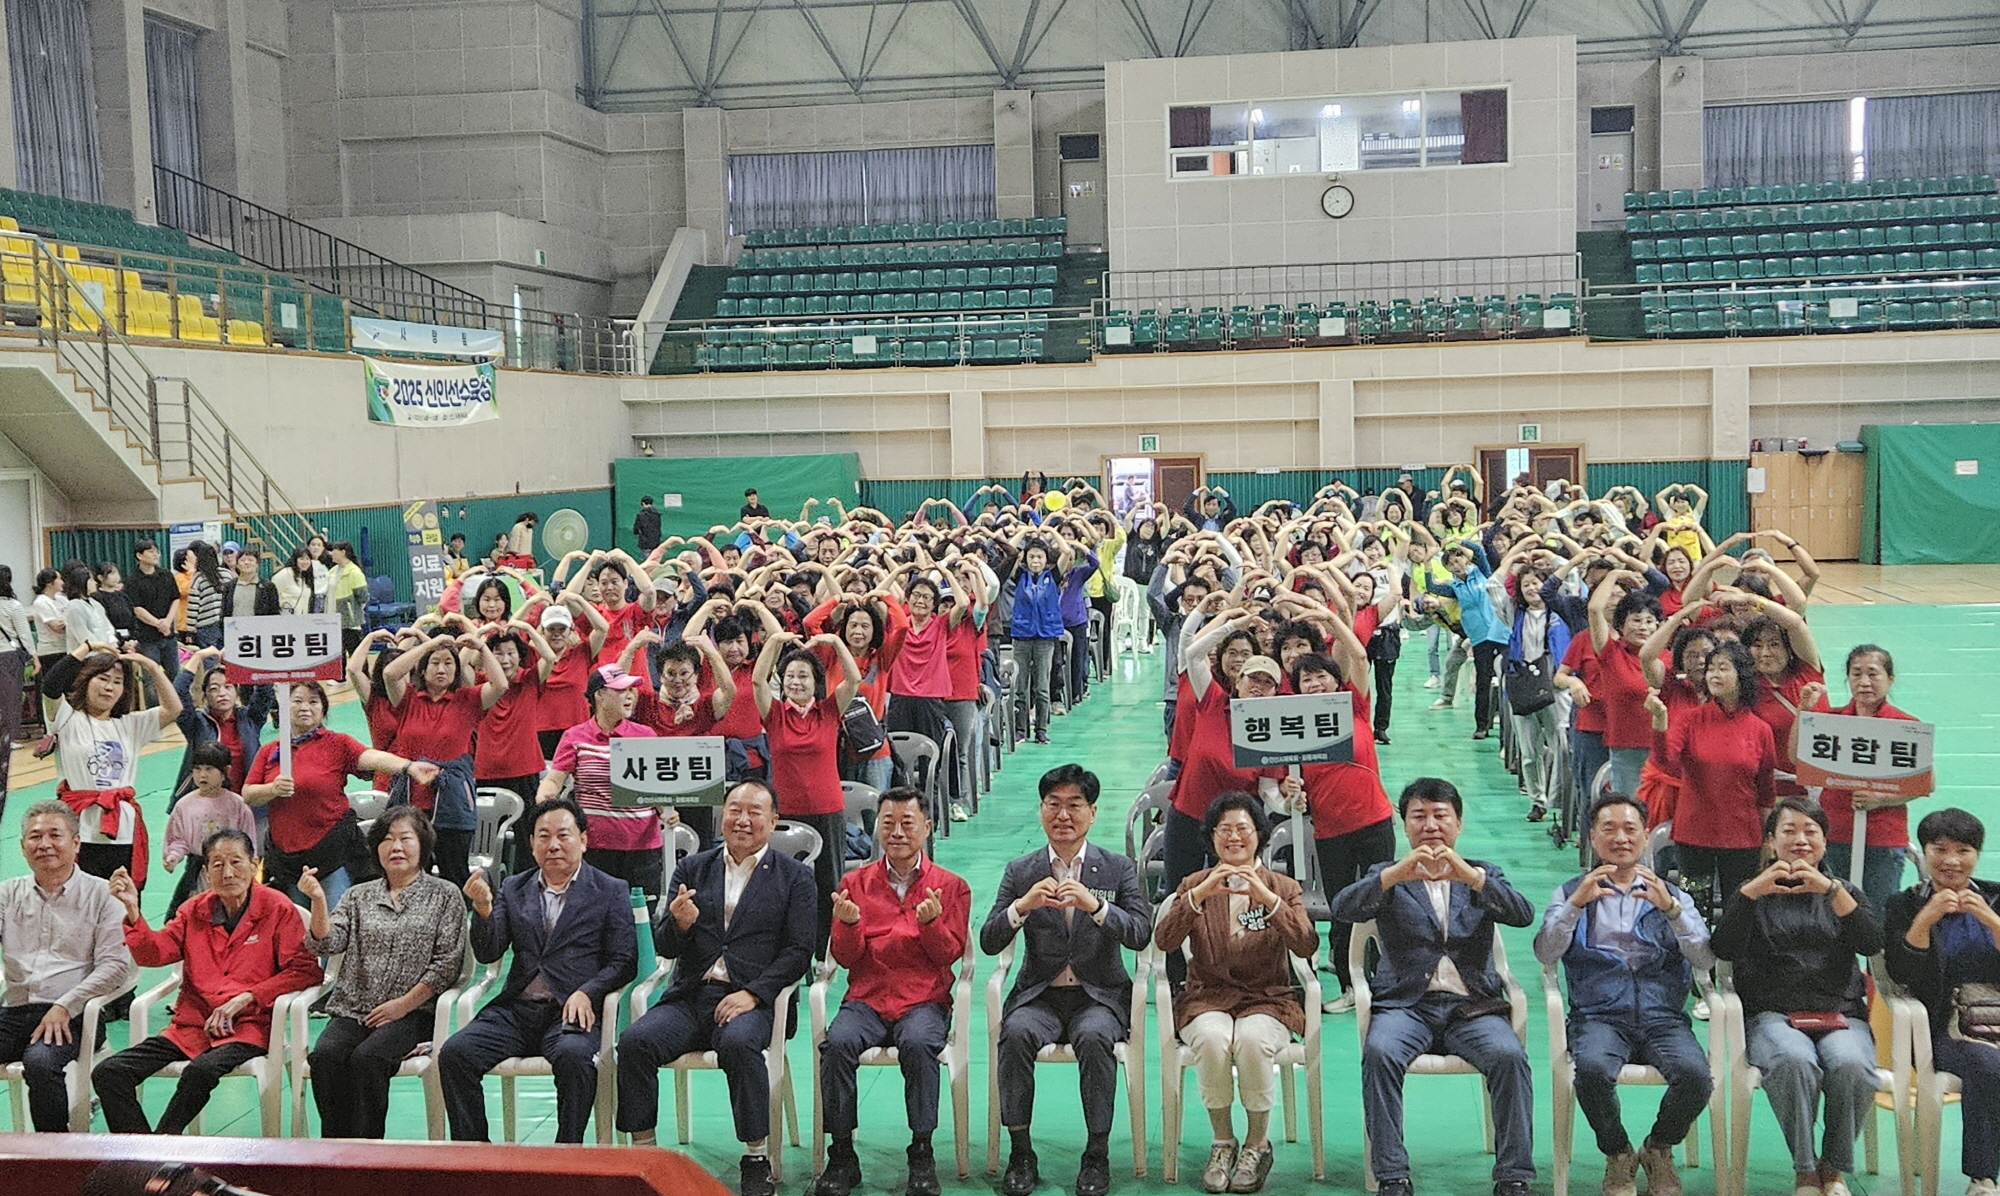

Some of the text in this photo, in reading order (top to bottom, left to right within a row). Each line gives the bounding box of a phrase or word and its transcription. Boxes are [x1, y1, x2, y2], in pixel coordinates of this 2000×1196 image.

[393, 377, 491, 408] 2025 신인선수육성
[412, 554, 442, 574] 의료
[415, 577, 444, 599] 지원
[238, 632, 328, 658] 희망팀
[1244, 712, 1339, 742] 행복팀
[1811, 733, 1918, 768] 화합팀
[622, 756, 712, 781] 사랑팀
